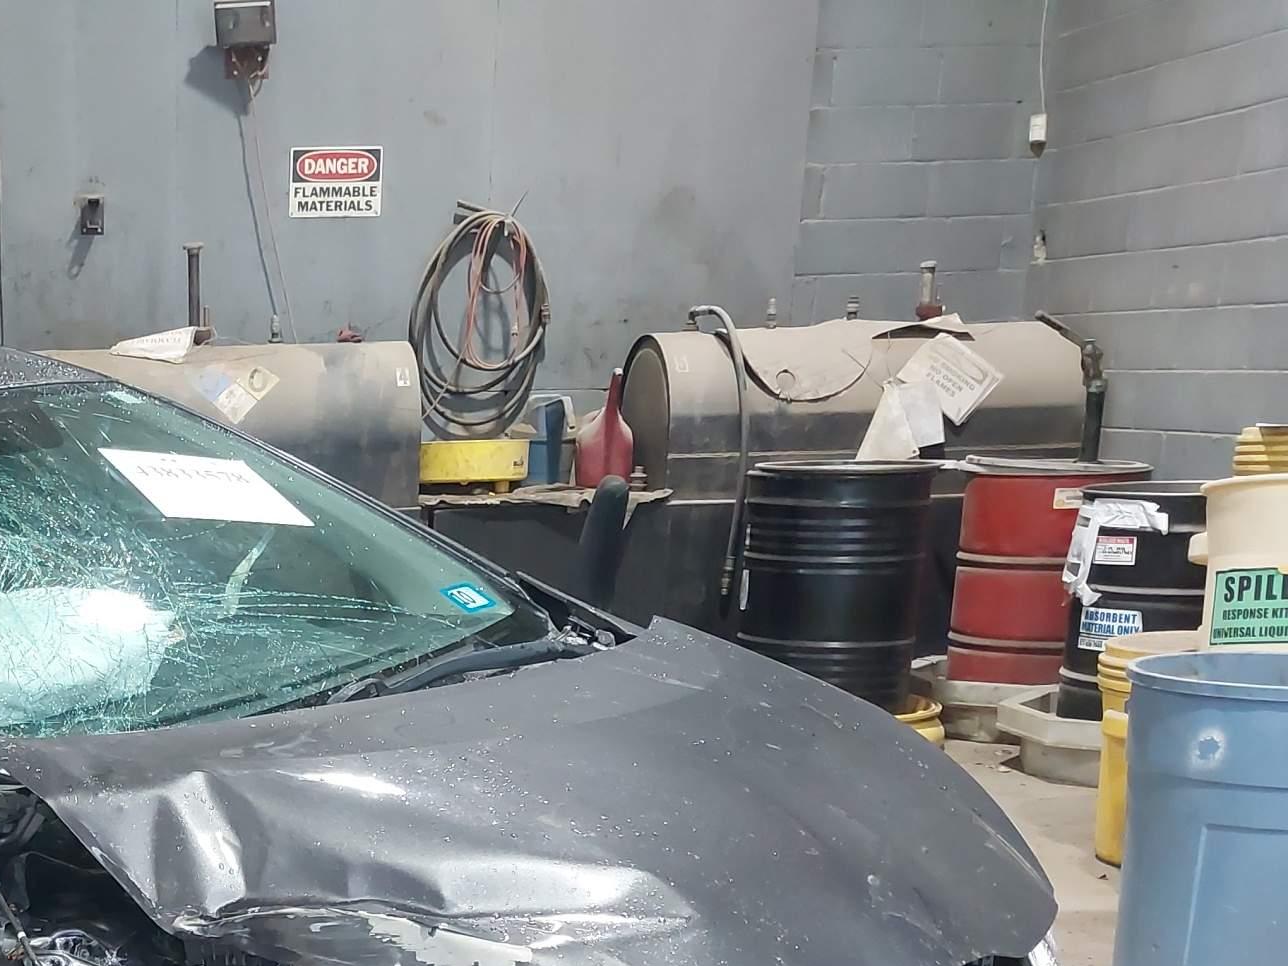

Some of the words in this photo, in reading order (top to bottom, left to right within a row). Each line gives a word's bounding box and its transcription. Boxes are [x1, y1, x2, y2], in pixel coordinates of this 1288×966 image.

[304, 158, 369, 175] DANGER
[294, 186, 378, 198] FLAMMABLE
[297, 200, 373, 212] MATERIALS
[1085, 609, 1138, 625] ABSORBENT
[1222, 608, 1270, 620] RESPONSE
[1082, 621, 1115, 636] MATERIAL
[1213, 627, 1256, 639] UNIVERSAL
